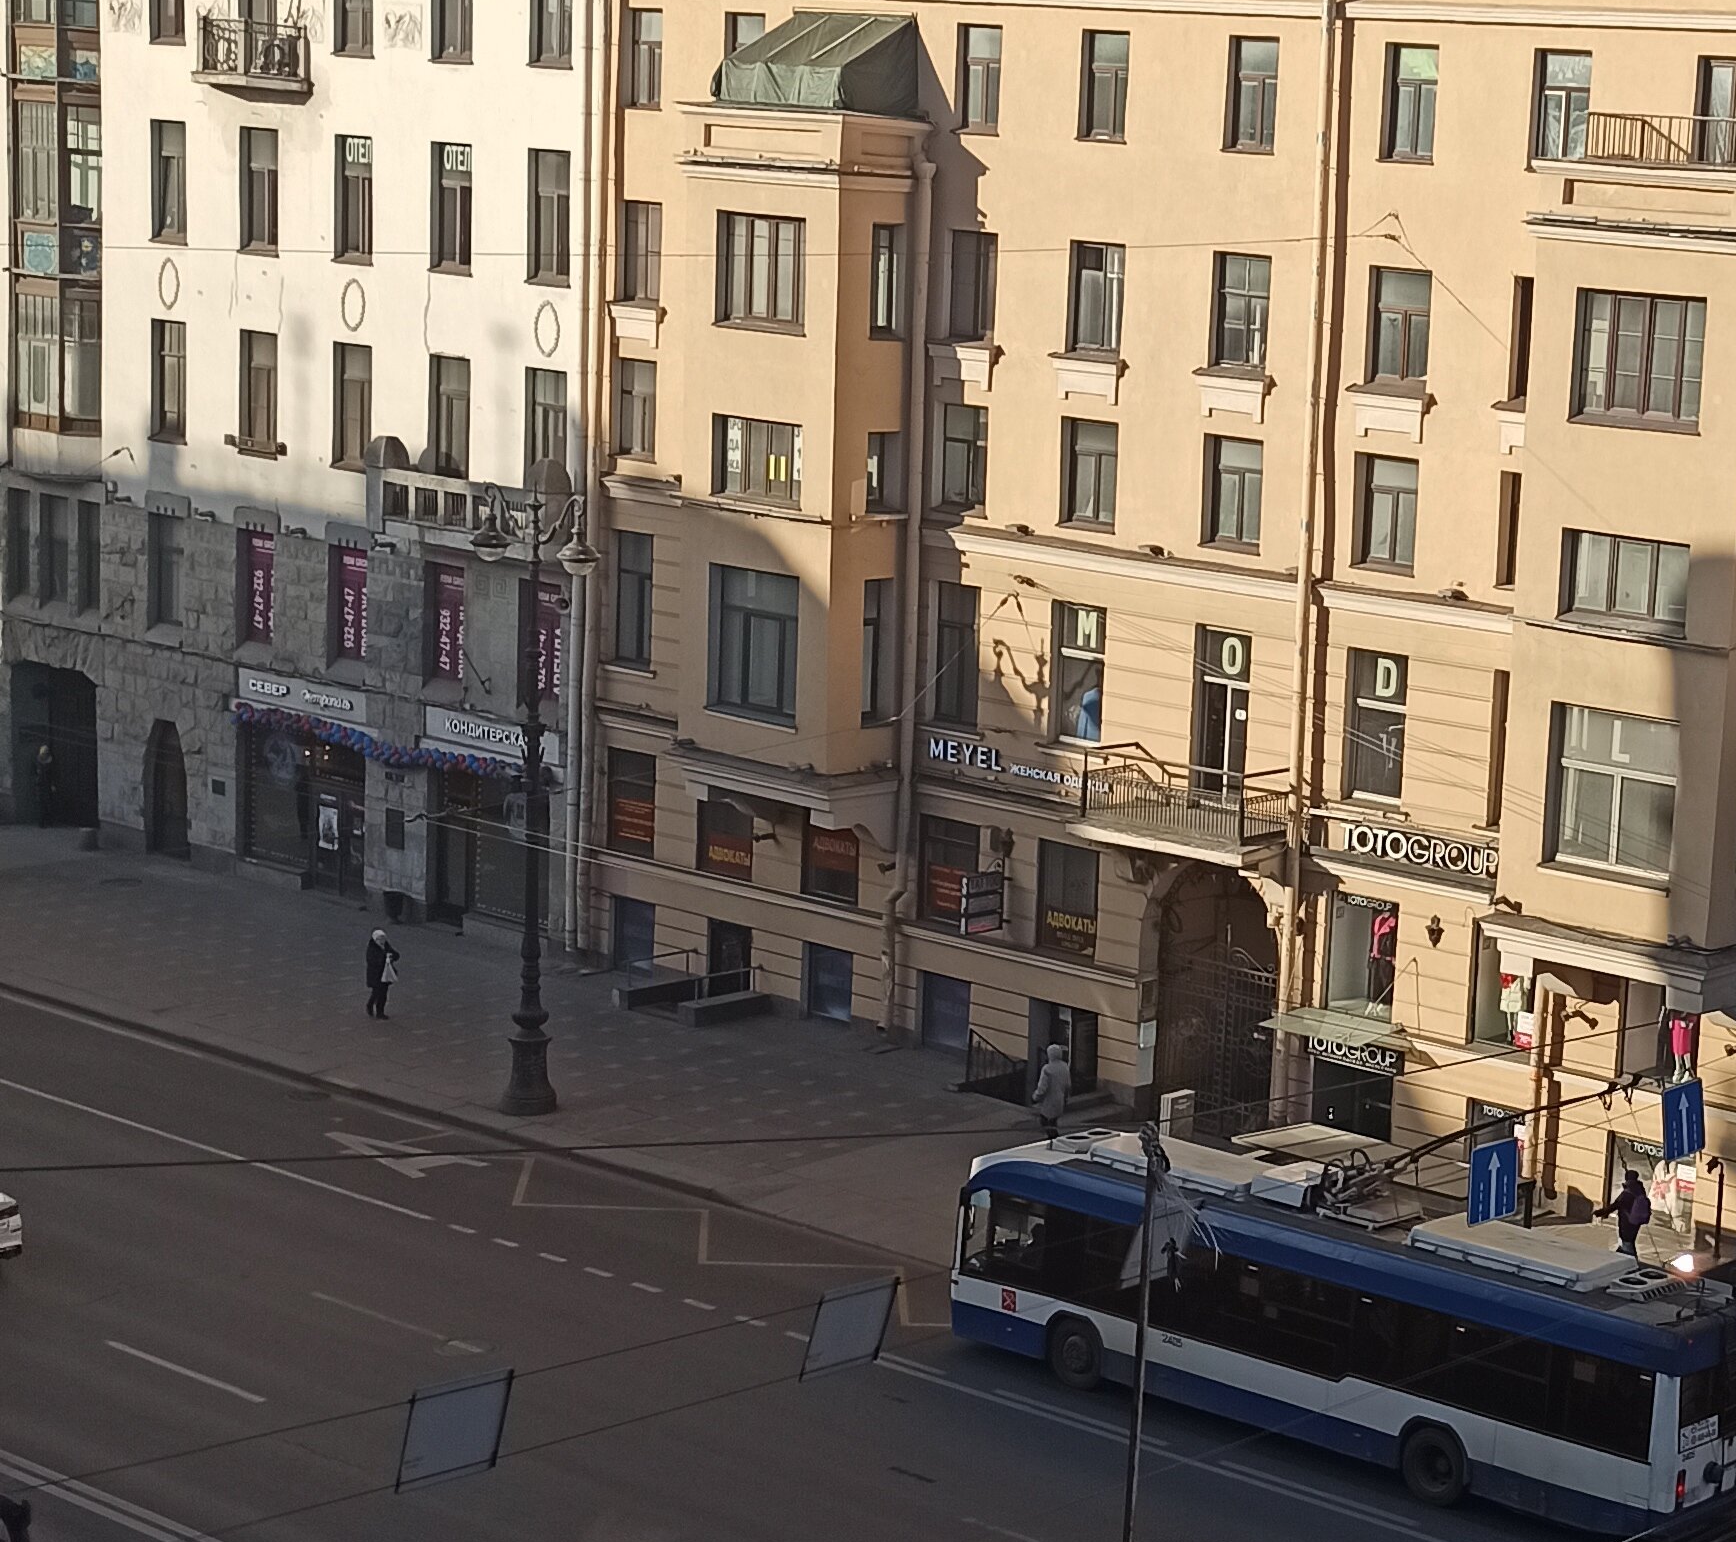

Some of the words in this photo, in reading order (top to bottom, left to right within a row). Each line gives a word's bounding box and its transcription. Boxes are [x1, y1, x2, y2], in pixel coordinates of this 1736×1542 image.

[253, 569, 264, 630] 932-47-47
[343, 587, 355, 649] 932-47-47
[439, 609, 451, 671] 932-47-47
[249, 678, 288, 697] СЕВЕР
[445, 718, 528, 749] КОНДИТЕРСКА
[929, 737, 1002, 772] MEYEL
[1010, 763, 1061, 784] ЖЕНСКАЯ
[1340, 823, 1499, 876] TOTOGROUP
[1046, 910, 1097, 933] АДВОКАТЫ
